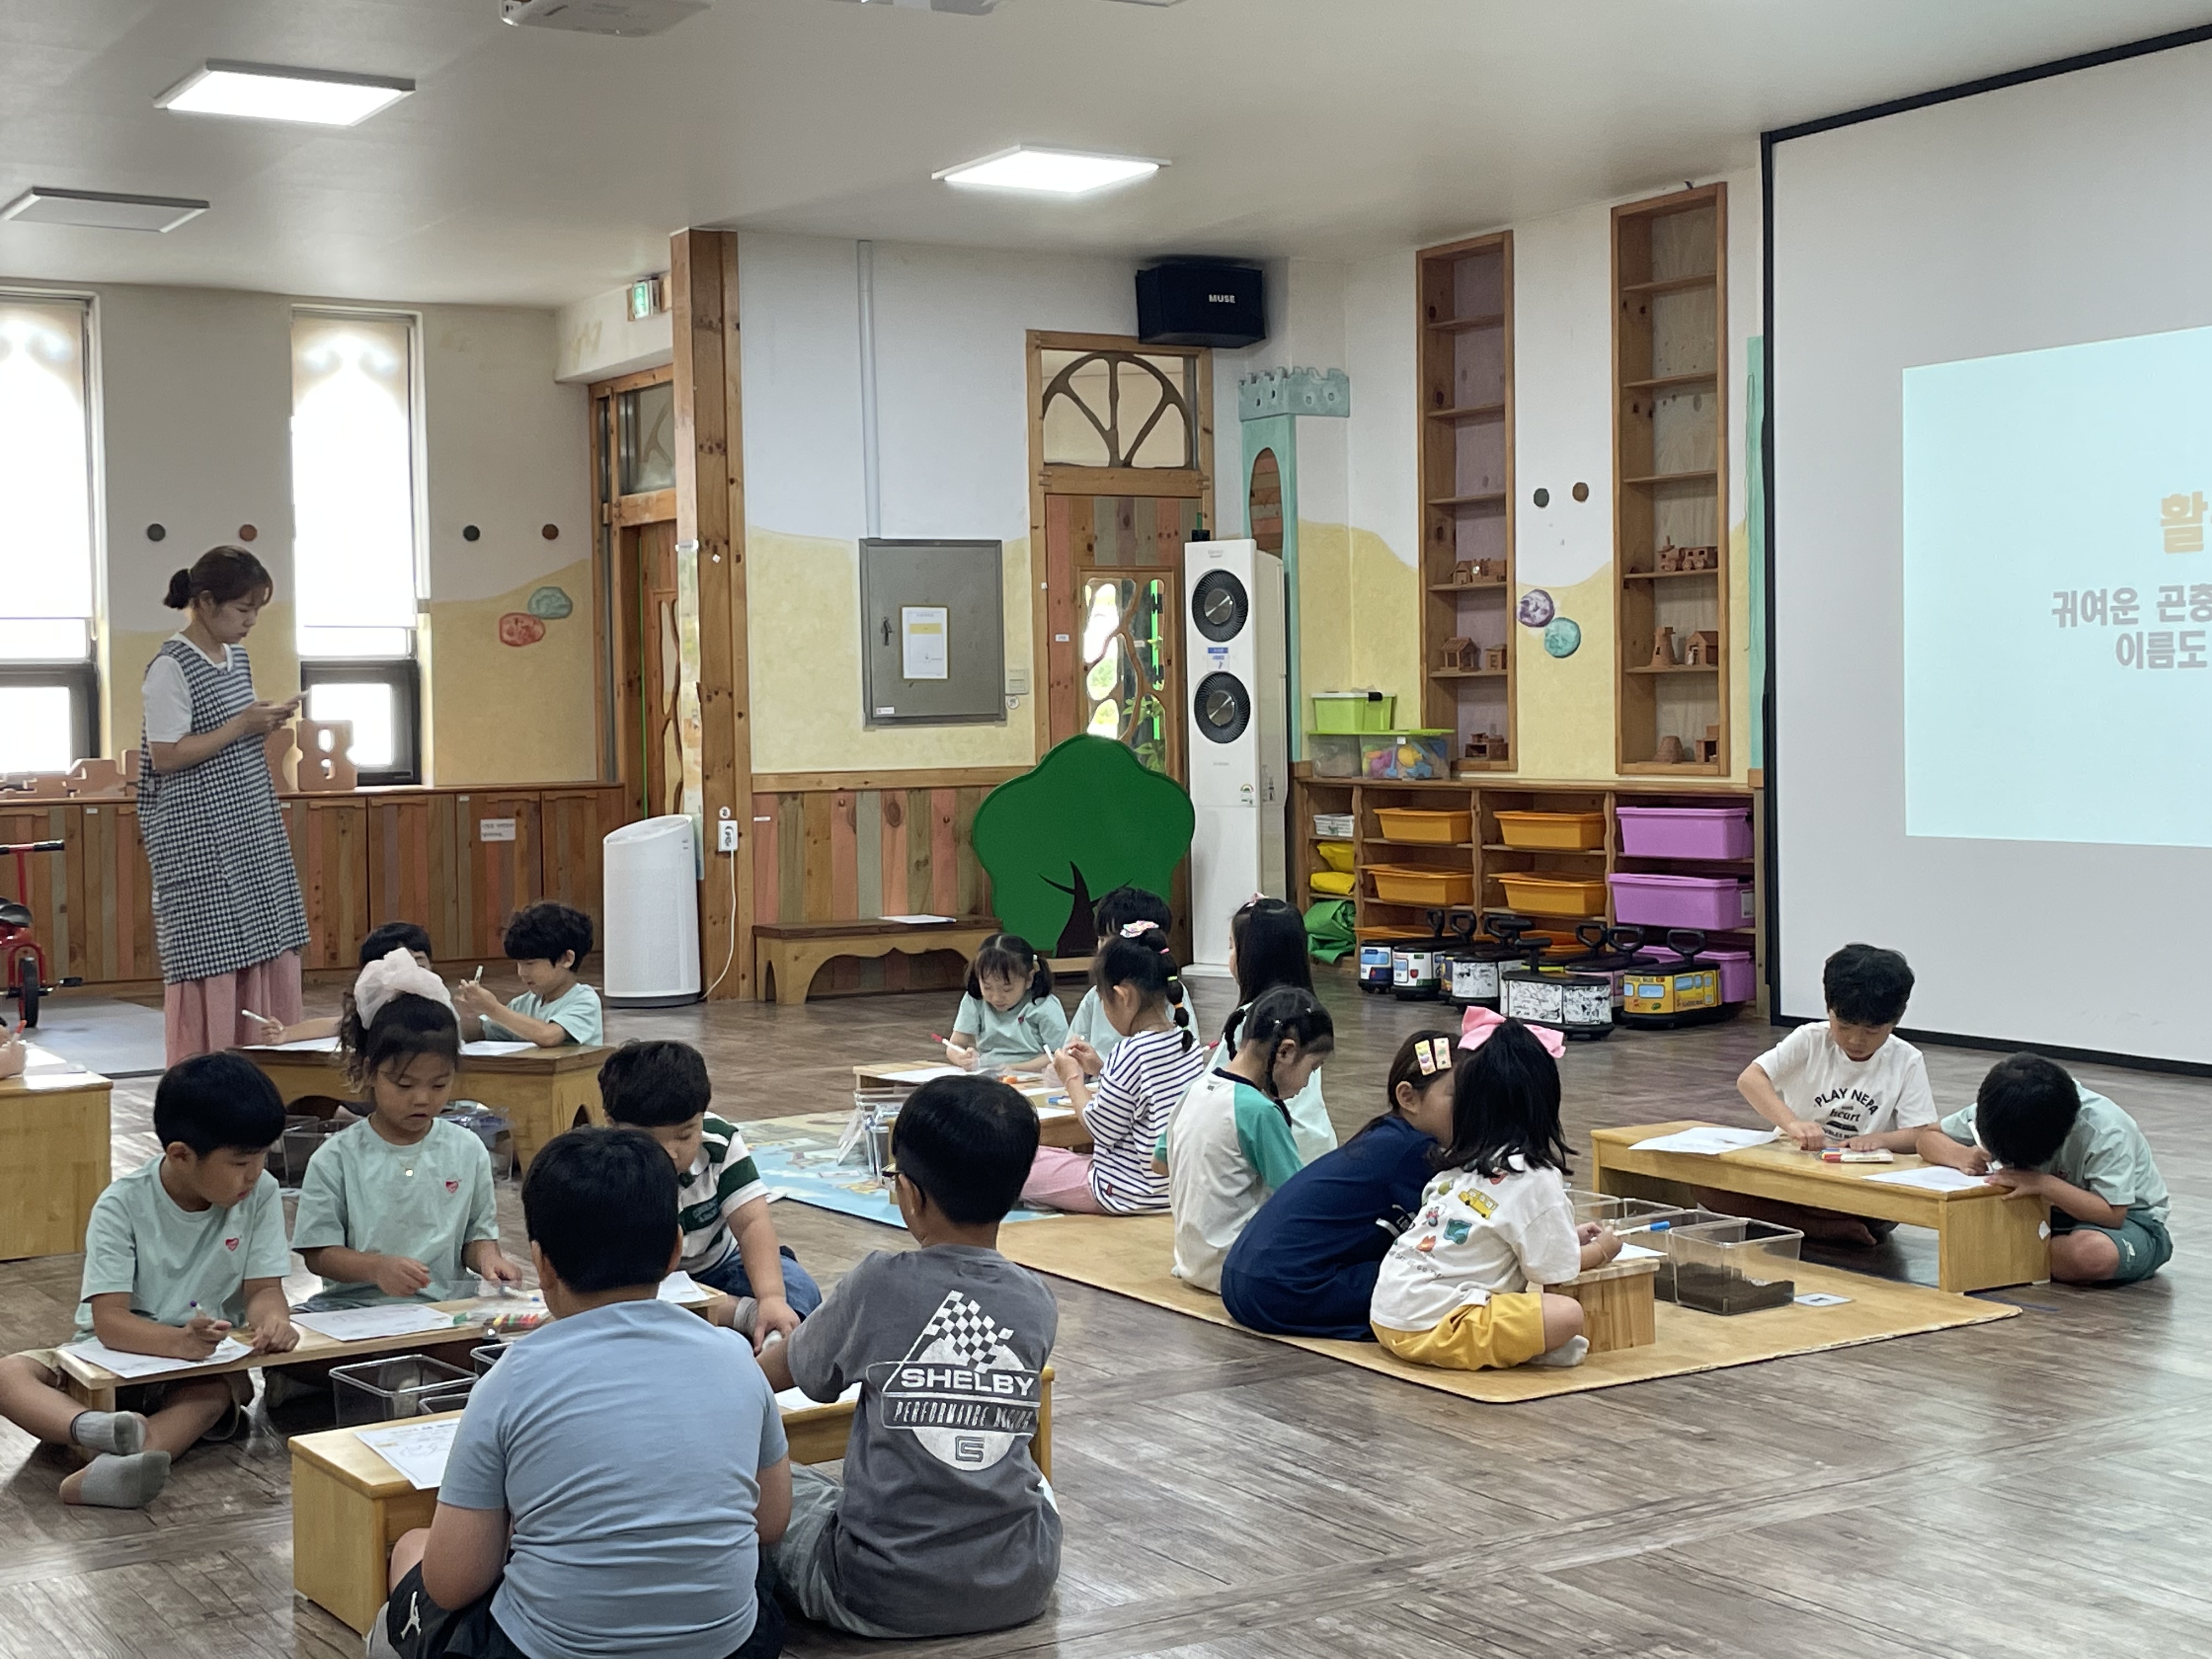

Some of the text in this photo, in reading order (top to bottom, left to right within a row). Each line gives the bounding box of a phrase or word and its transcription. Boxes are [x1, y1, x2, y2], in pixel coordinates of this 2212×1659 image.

[1209, 294, 1235, 303] MUSE
[2160, 491, 2212, 554] 활
[2051, 583, 2212, 628] 귀여운 곤충
[2115, 630, 2208, 670] 이름도
[1814, 1087, 1879, 1115] PLAY NEPA
[901, 1368, 1035, 1396] SHELBY
